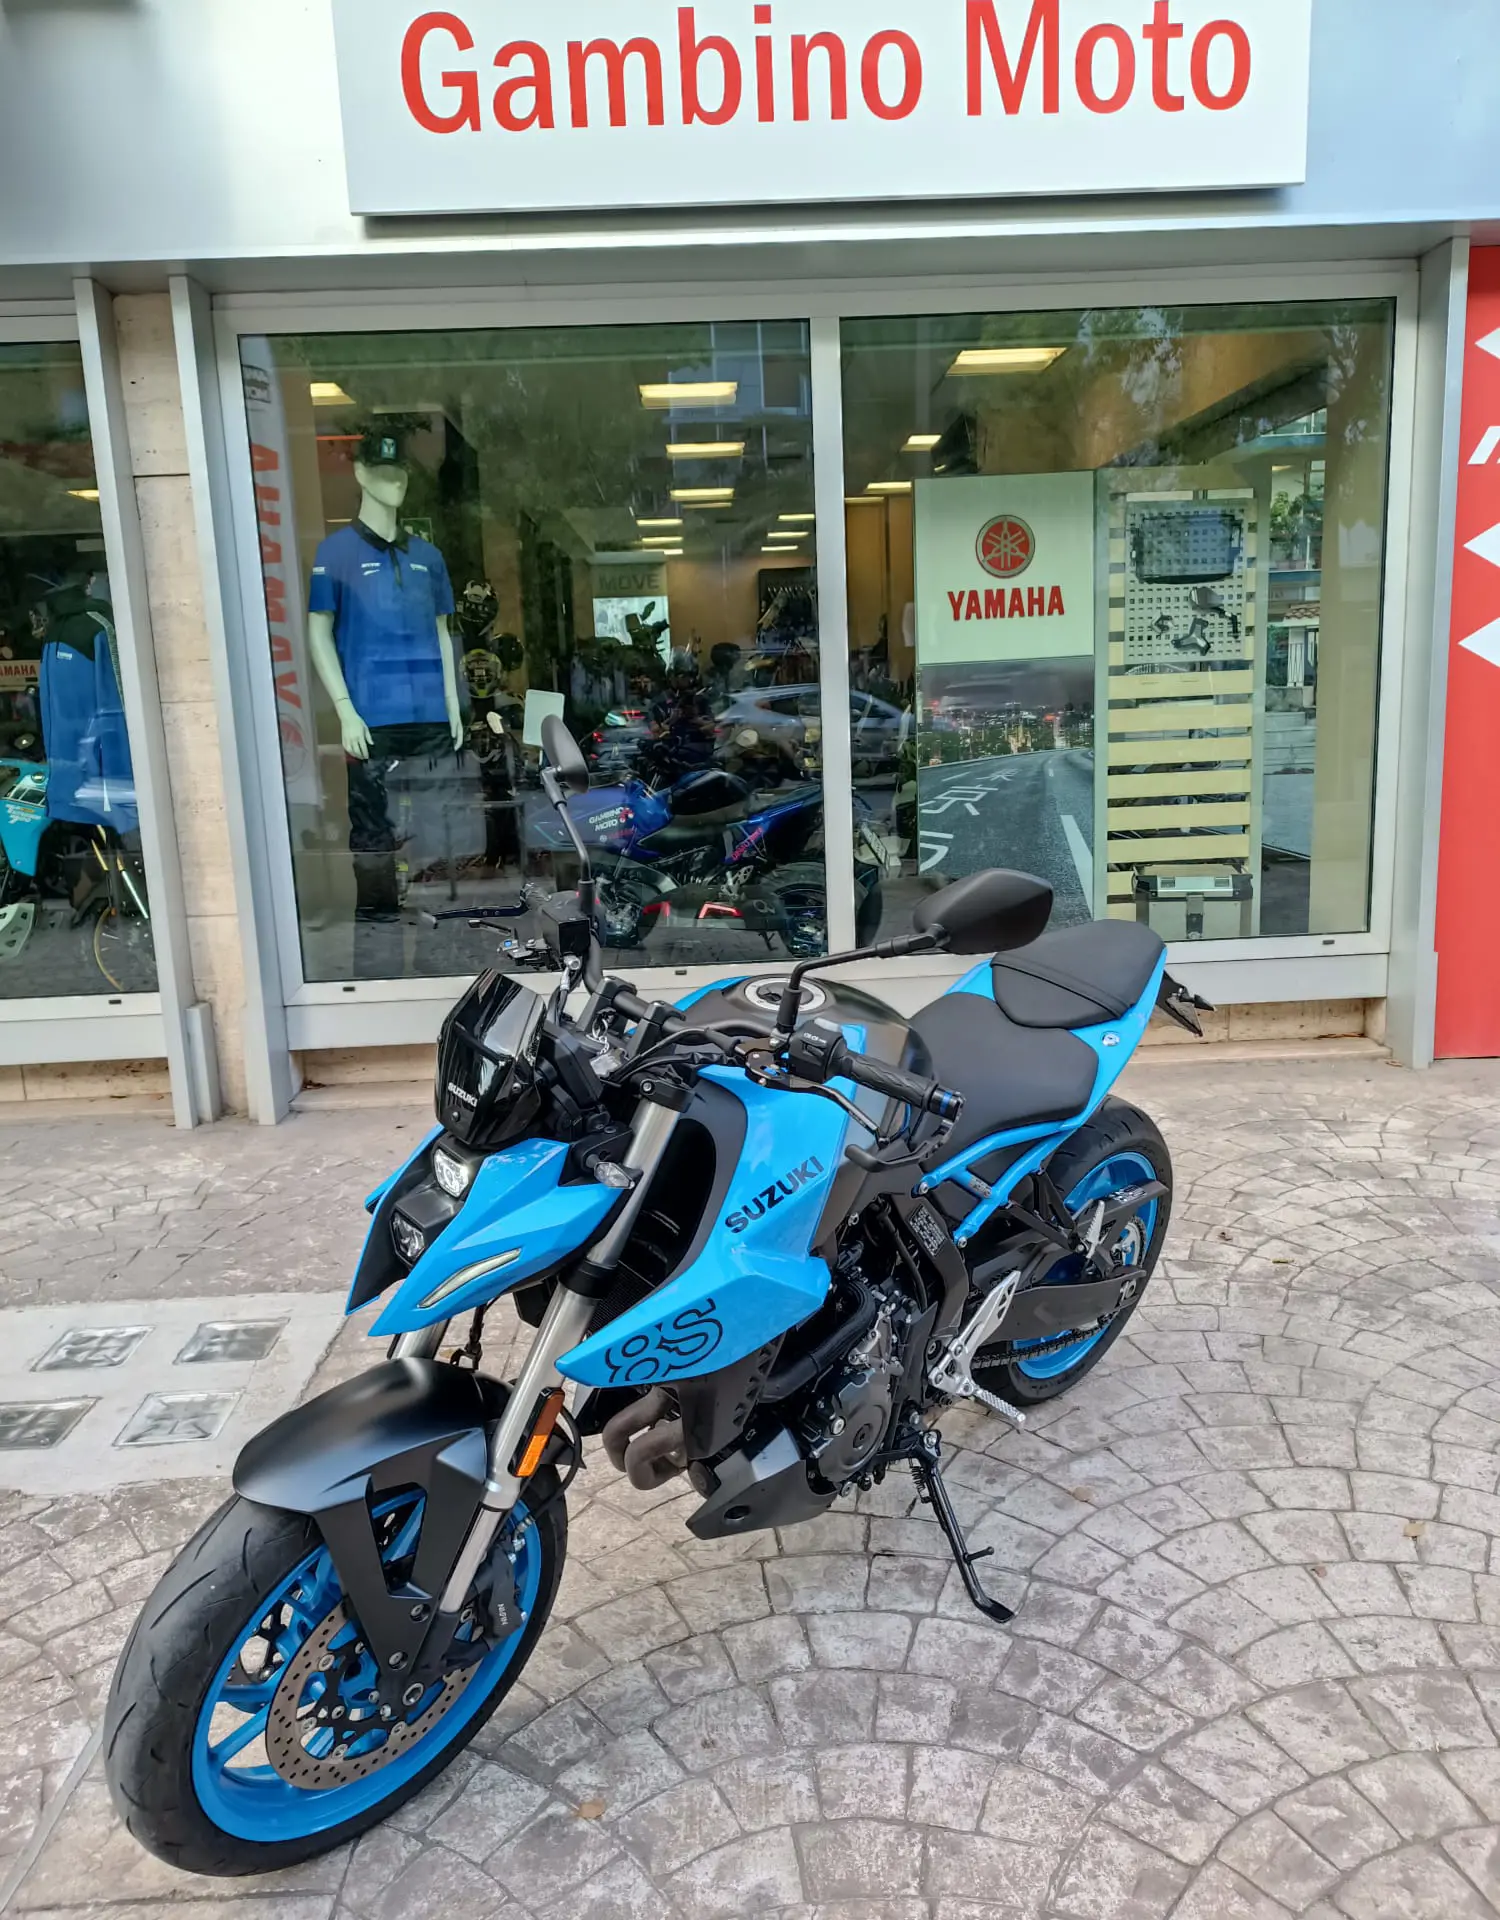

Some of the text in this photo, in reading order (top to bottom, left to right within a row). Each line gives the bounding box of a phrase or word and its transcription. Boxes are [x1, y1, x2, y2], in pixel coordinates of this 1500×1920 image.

[401, 0, 1252, 134] Gambino Moto
[599, 573, 660, 592] MOVE
[947, 585, 1065, 621] YAMAHA
[447, 1081, 478, 1108] SUZUKI
[724, 1155, 825, 1234] SUZUKI
